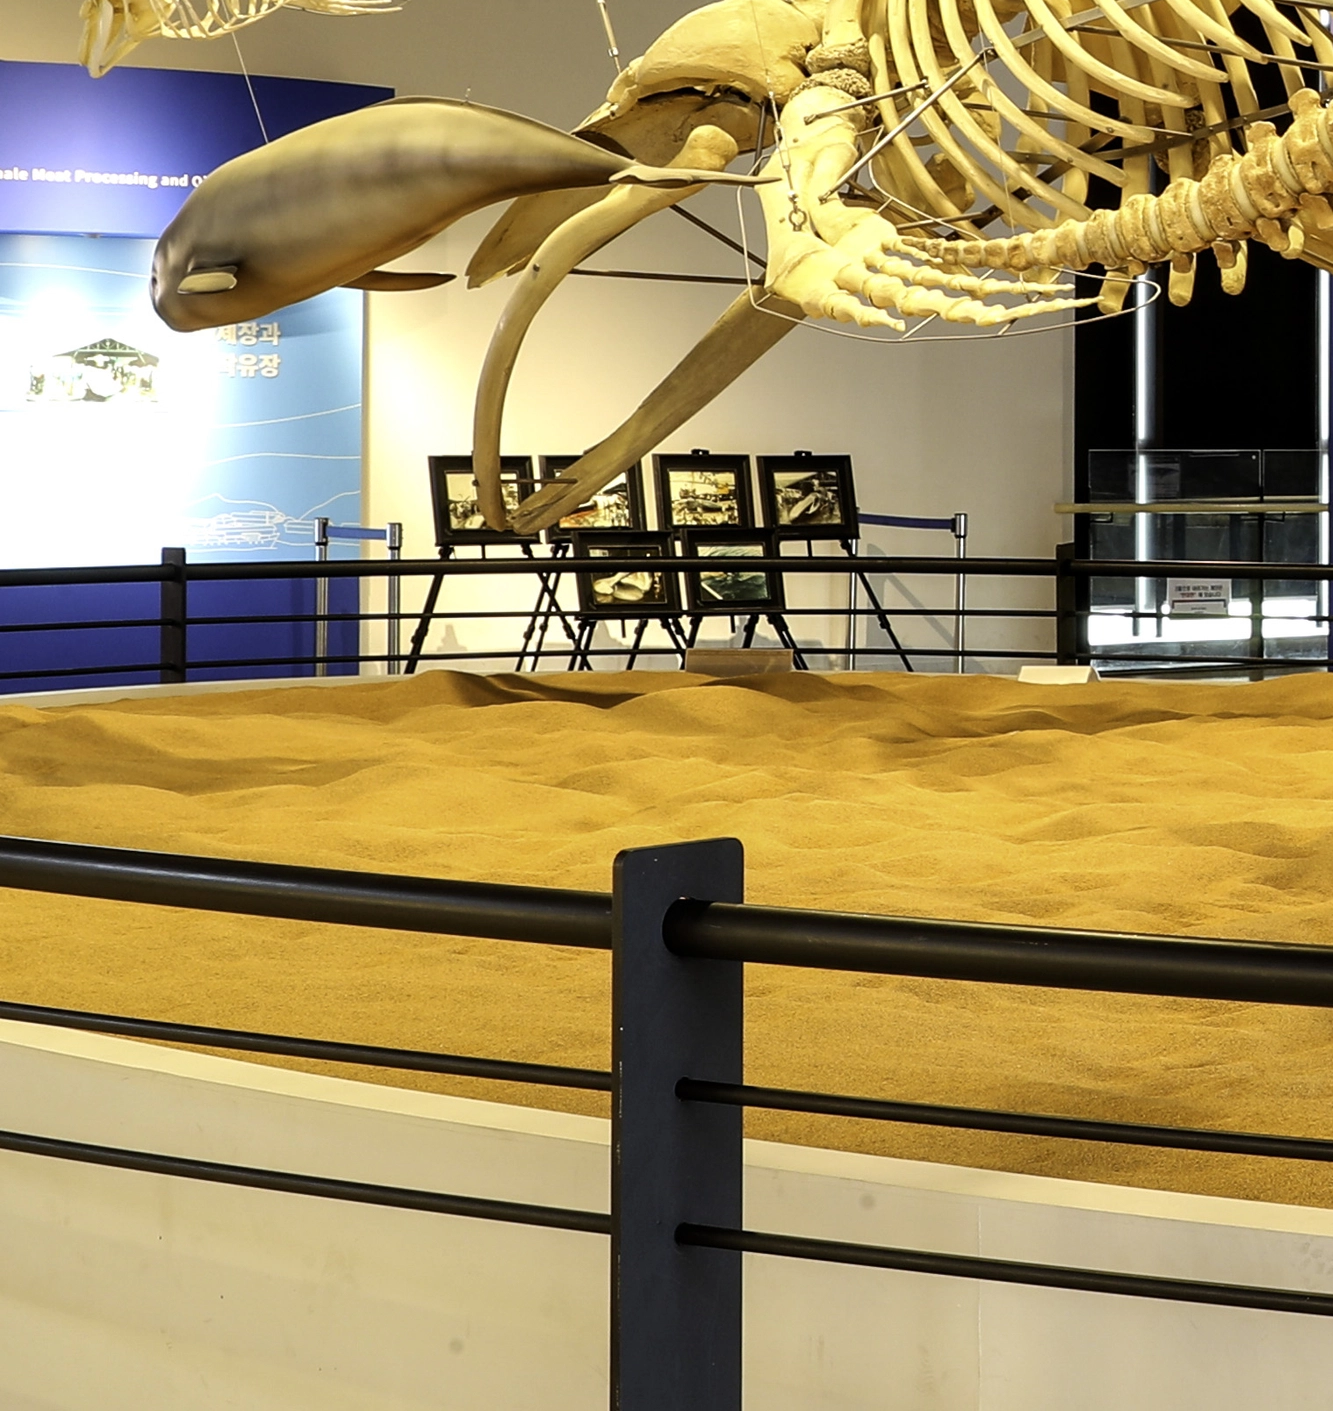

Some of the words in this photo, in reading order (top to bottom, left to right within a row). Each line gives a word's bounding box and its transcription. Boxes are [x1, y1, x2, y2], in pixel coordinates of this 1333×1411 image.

[32, 168, 71, 183] Meat
[75, 169, 158, 189] Processing
[161, 174, 188, 187] and
